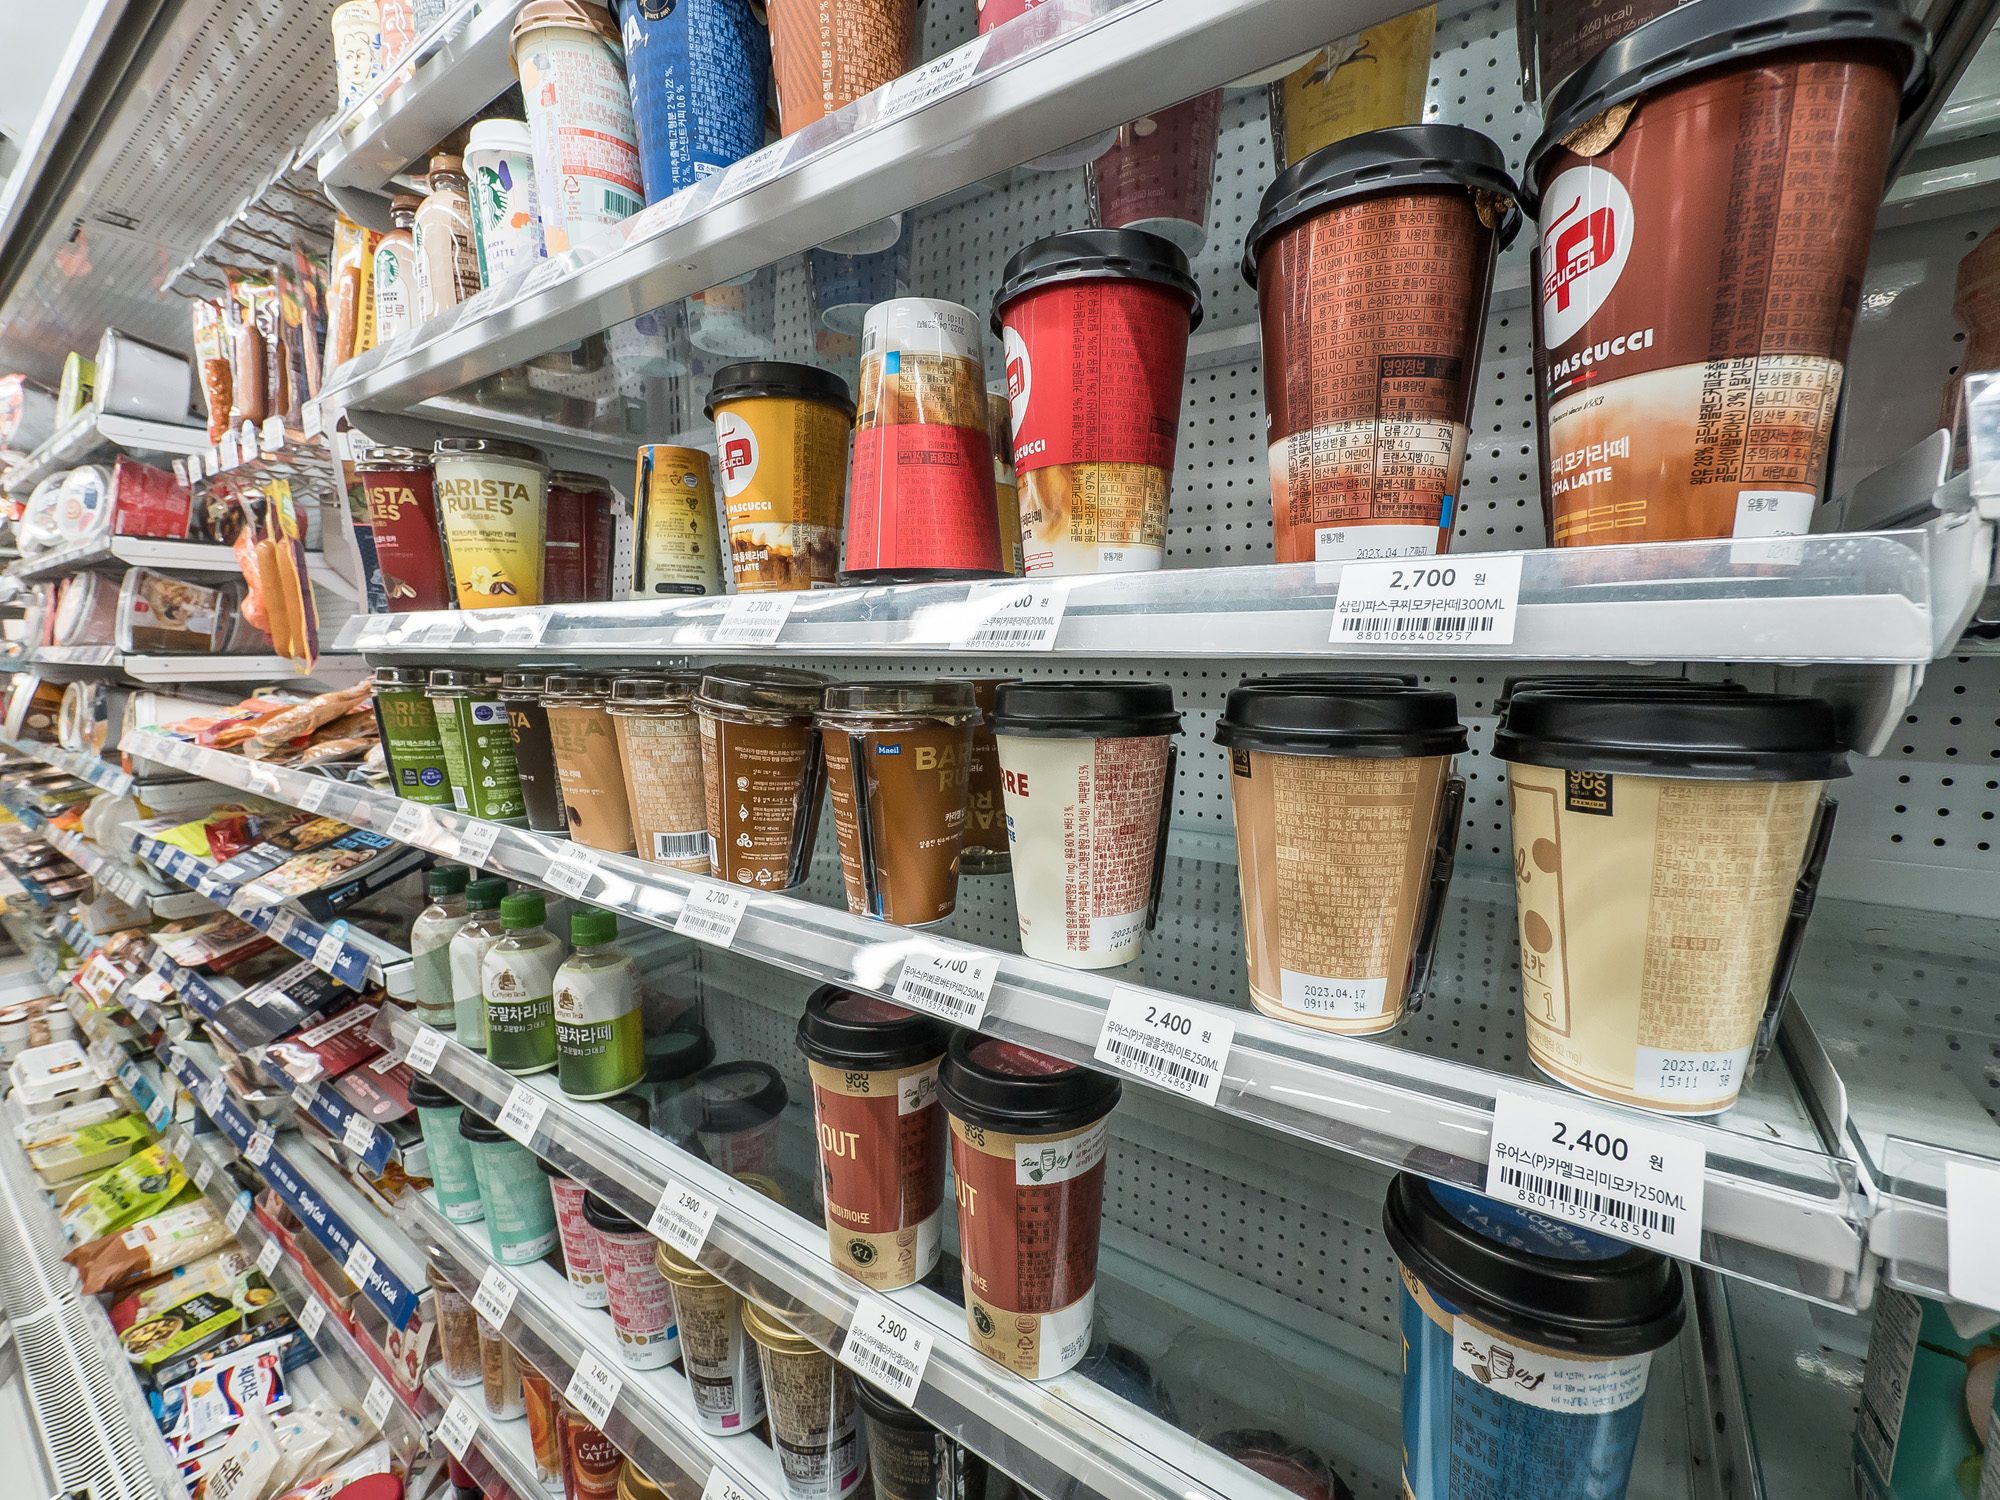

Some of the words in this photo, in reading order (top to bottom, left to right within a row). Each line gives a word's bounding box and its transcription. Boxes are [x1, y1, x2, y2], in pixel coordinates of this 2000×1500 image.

[820, 13, 830, 24] 32
[1604, 4, 1633, 26] kcal)
[916, 58, 954, 83] 2,900
[665, 79, 674, 88] 22
[677, 95, 686, 108] 0.6
[1328, 223, 1354, 239] 제품은
[1406, 229, 1429, 243] 사용한
[1312, 255, 1349, 275] 조시설에서
[1353, 251, 1387, 266] 제조하고
[1390, 246, 1426, 261] 있습니다.
[1433, 246, 1448, 258] 제품
[1312, 278, 1327, 291] 분에
[1348, 268, 1373, 284] 부유물
[1375, 265, 1391, 279] 또는
[1395, 262, 1420, 277] 침전이
[1422, 261, 1438, 274] 생길
[1312, 291, 1334, 308] 질에는
[1337, 284, 1362, 298] 이상이
[1364, 279, 1400, 294] 없으므로
[1402, 277, 1427, 291] 흔들어
[1319, 304, 1342, 319] 용기가
[1367, 294, 1418, 312] 손상되었거나
[1312, 321, 1327, 336] 었을
[1330, 318, 1346, 333] 경우
[1349, 310, 1384, 327] 음용하지
[1330, 331, 1354, 346] 있으니
[1357, 327, 1375, 340] 차내
[1389, 324, 1414, 338] 고온의
[1313, 352, 1328, 364] 두지
[1372, 340, 1421, 355] 전자레인지나
[1554, 328, 1654, 381] PASCUCCI
[1087, 357, 1098, 374] 원유
[1313, 363, 1346, 379] 마십시오.
[1383, 359, 1426, 375] 영양정보
[1332, 374, 1375, 391] 공정거래위
[1313, 395, 1329, 408] 원회
[1331, 392, 1347, 404] 고시
[1350, 389, 1375, 402] 소비자
[1583, 395, 1604, 410] 1883
[1314, 410, 1329, 423] 분쟁
[1331, 404, 1374, 420] 해결기준에
[1335, 421, 1351, 434] 교환
[1355, 419, 1373, 431] 또는
[1384, 425, 1400, 437] 당류
[1438, 427, 1452, 438] 27%
[1314, 436, 1347, 451] 보상받을
[1379, 439, 1395, 451] 지방
[1383, 452, 1423, 464] 트랜스지방
[1565, 435, 1629, 472] 모카라떼
[1746, 445, 1789, 463] 주의하여
[1344, 462, 1372, 476] 카페인
[1382, 466, 1414, 477] 포화지방
[1314, 479, 1344, 493] 민감자는
[1346, 477, 1370, 490] 섭취에
[1375, 479, 1416, 490] 콜레스테롤
[1571, 466, 1612, 491] LATTE
[438, 478, 531, 502] BARISTA
[1315, 492, 1347, 506] 주의하여
[1352, 490, 1370, 502] 주시
[1374, 492, 1400, 503] 단백질
[447, 497, 514, 515] RULES
[729, 501, 772, 514] PASCUCCI
[1747, 497, 1778, 512] 유통기한
[1320, 533, 1345, 544] 유통기한
[1103, 551, 1123, 562] 유통기한
[743, 562, 760, 572] LATTE
[1390, 569, 1456, 590] 2,700
[1473, 573, 1486, 586] 원
[747, 602, 772, 612] 2,700
[1339, 598, 1505, 613] 삼립)파스쿠찌모카라떼300ML
[1357, 631, 1472, 641] 8801068402957
[877, 746, 900, 755] Maeil
[1078, 764, 1089, 780] 0.5%
[1078, 781, 1090, 804] 커피분말
[1325, 784, 1336, 793] 508
[1571, 800, 1606, 809] PREMIUM
[1064, 818, 1075, 830] 버터
[1079, 823, 1089, 838] 3.2%
[1078, 839, 1090, 850] 함량
[1065, 848, 1076, 859] 원유
[706, 889, 729, 905] 2,700
[1079, 913, 1089, 929] 블렌딩
[1079, 930, 1090, 952] 예가체프
[973, 968, 982, 979] 원
[1304, 985, 1366, 999] 2023.04.17
[908, 993, 964, 1019] 8801155742461
[1304, 999, 1335, 1011] 09:14
[1145, 1006, 1192, 1035] 2,400
[1202, 1030, 1212, 1044] 원
[1107, 1020, 1219, 1072] 유어스(P)카멜플랫화이트250ML
[1114, 1055, 1193, 1092] 8801155724863
[1662, 1059, 1732, 1072] 2023.02.21
[1659, 1075, 1698, 1089] 15:11
[822, 1123, 860, 1160] OUT
[1551, 1121, 1628, 1161] 2,400
[1649, 1154, 1664, 1172] 원
[1021, 1157, 1039, 1169] Size
[1495, 1142, 1687, 1212] 유어스(P)카멜크리미모카250ML
[679, 1193, 699, 1213] 2,900
[1517, 1189, 1652, 1240] 8801155724856
[853, 1245, 871, 1261] XL
[877, 1314, 907, 1342] 2,900
[1459, 1341, 1487, 1362] Size
[1515, 1368, 1535, 1387] Up
[591, 1365, 608, 1385] 2,400
